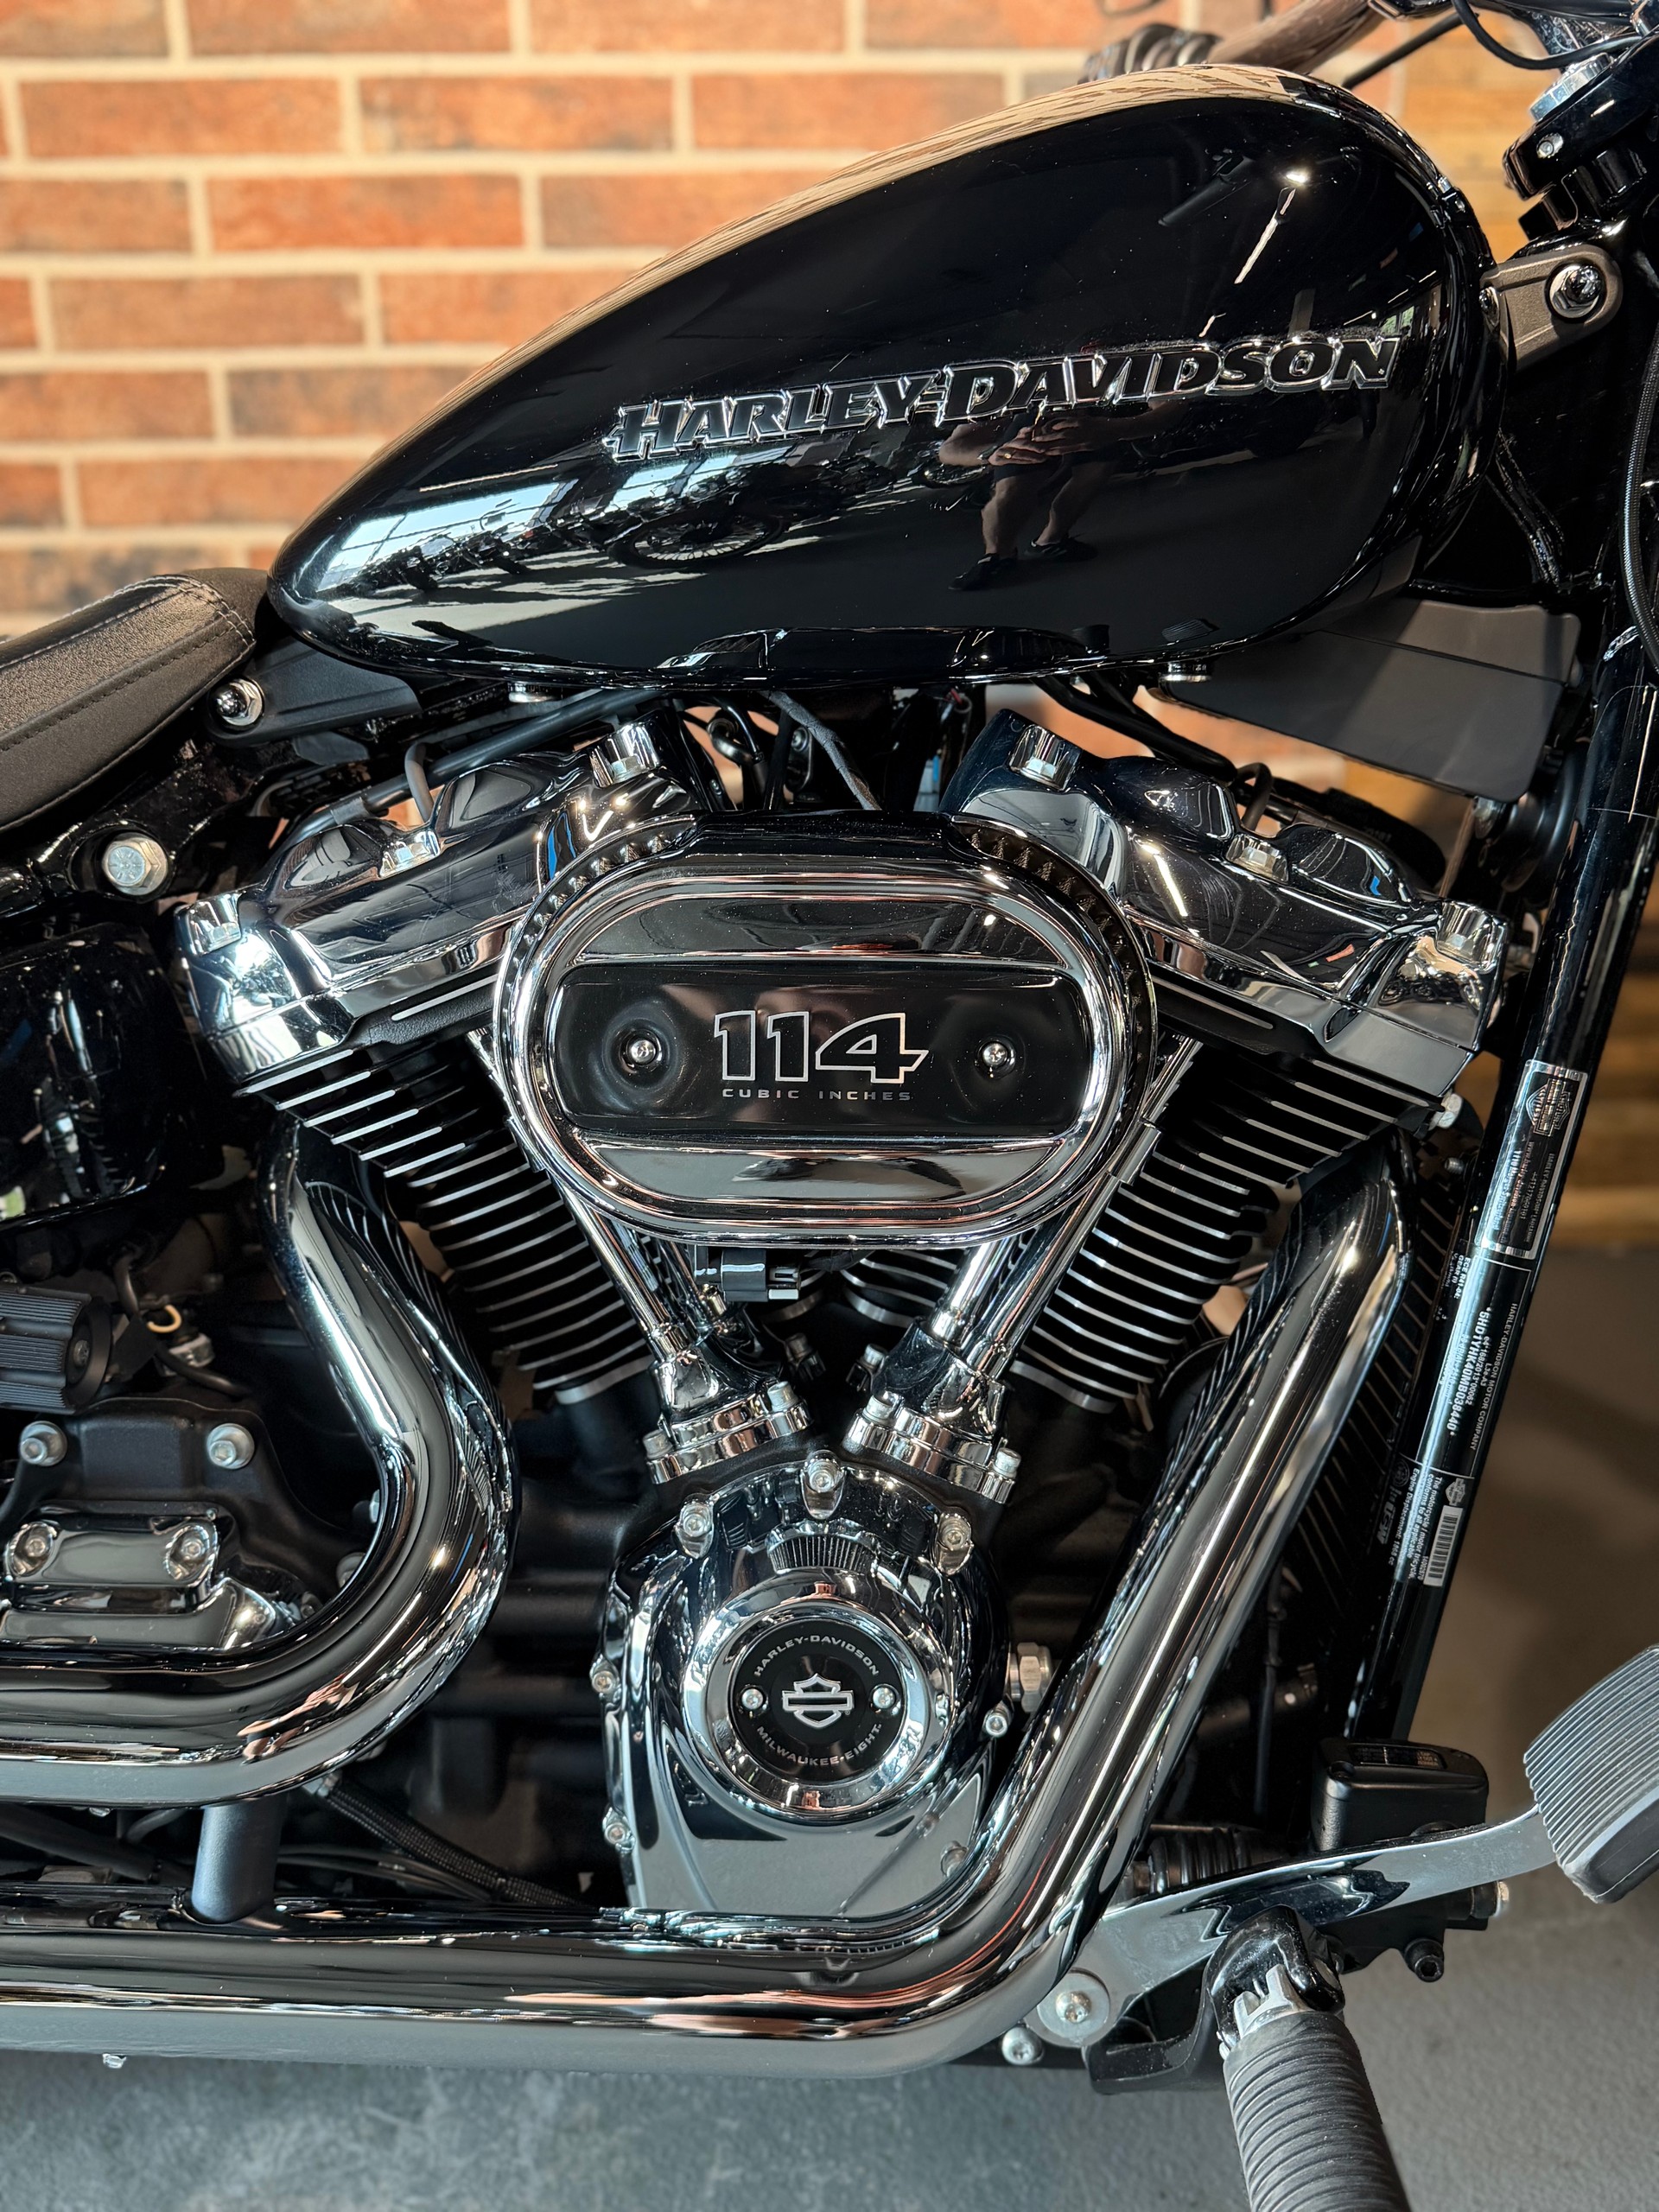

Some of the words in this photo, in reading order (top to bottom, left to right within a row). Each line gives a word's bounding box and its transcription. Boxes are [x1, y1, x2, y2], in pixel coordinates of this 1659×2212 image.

[602, 335, 1402, 463] HARLEY-DAVIDSON
[713, 1009, 930, 1084] 114
[722, 1088, 800, 1099] CUBIC
[818, 1090, 912, 1102] INCHES
[1453, 1255, 1464, 1275] GEAR
[1461, 1256, 1471, 1272] ECE
[1490, 1302, 1517, 1378] HARLEY-DAVIDSON
[1479, 1362, 1491, 1386] L3e-A3
[1480, 1379, 1495, 1409] MOTOR
[1469, 1410, 1485, 1450] COMPANY
[1407, 1467, 1420, 1491] Engine
[1420, 1473, 1434, 1505] conforms
[1433, 1476, 1441, 1489] The
[1395, 1491, 1413, 1539] Displacement:
[1414, 1514, 1423, 1523] all
[1423, 1489, 1438, 1528] motorcycle
[1406, 1523, 1421, 1558] applicable
[1414, 1531, 1426, 1552] motor
[1388, 1556, 1395, 1565] cc
[753, 1634, 879, 1677] HARLEY-DAVIDSON
